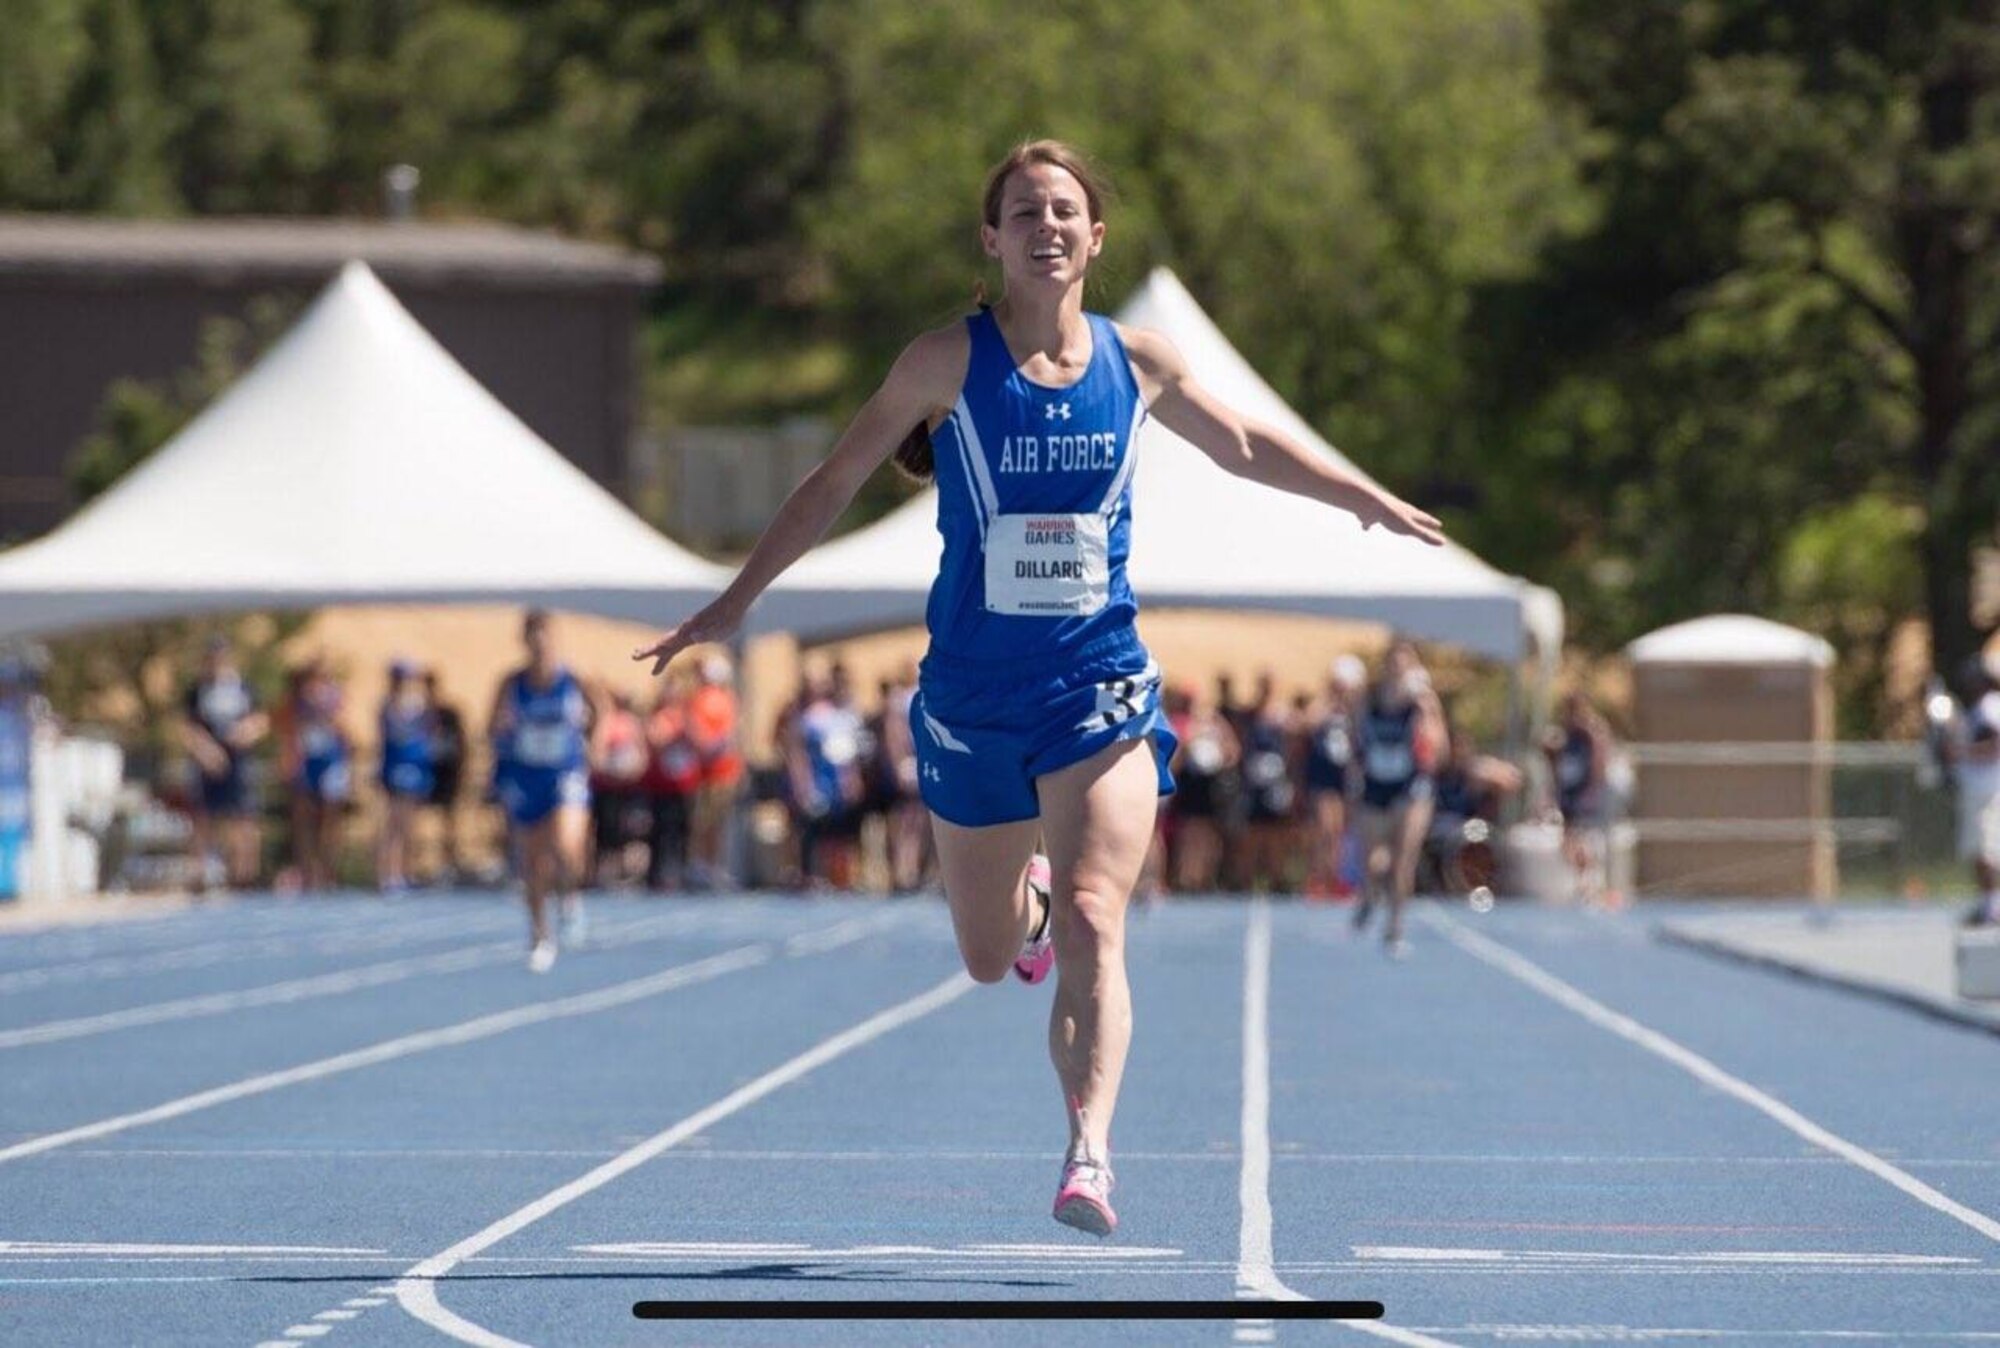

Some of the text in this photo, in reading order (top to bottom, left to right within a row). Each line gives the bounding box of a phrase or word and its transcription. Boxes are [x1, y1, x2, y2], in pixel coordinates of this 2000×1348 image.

[1000, 433, 1116, 472] AIR FORCE
[1025, 531, 1075, 545] GAMES
